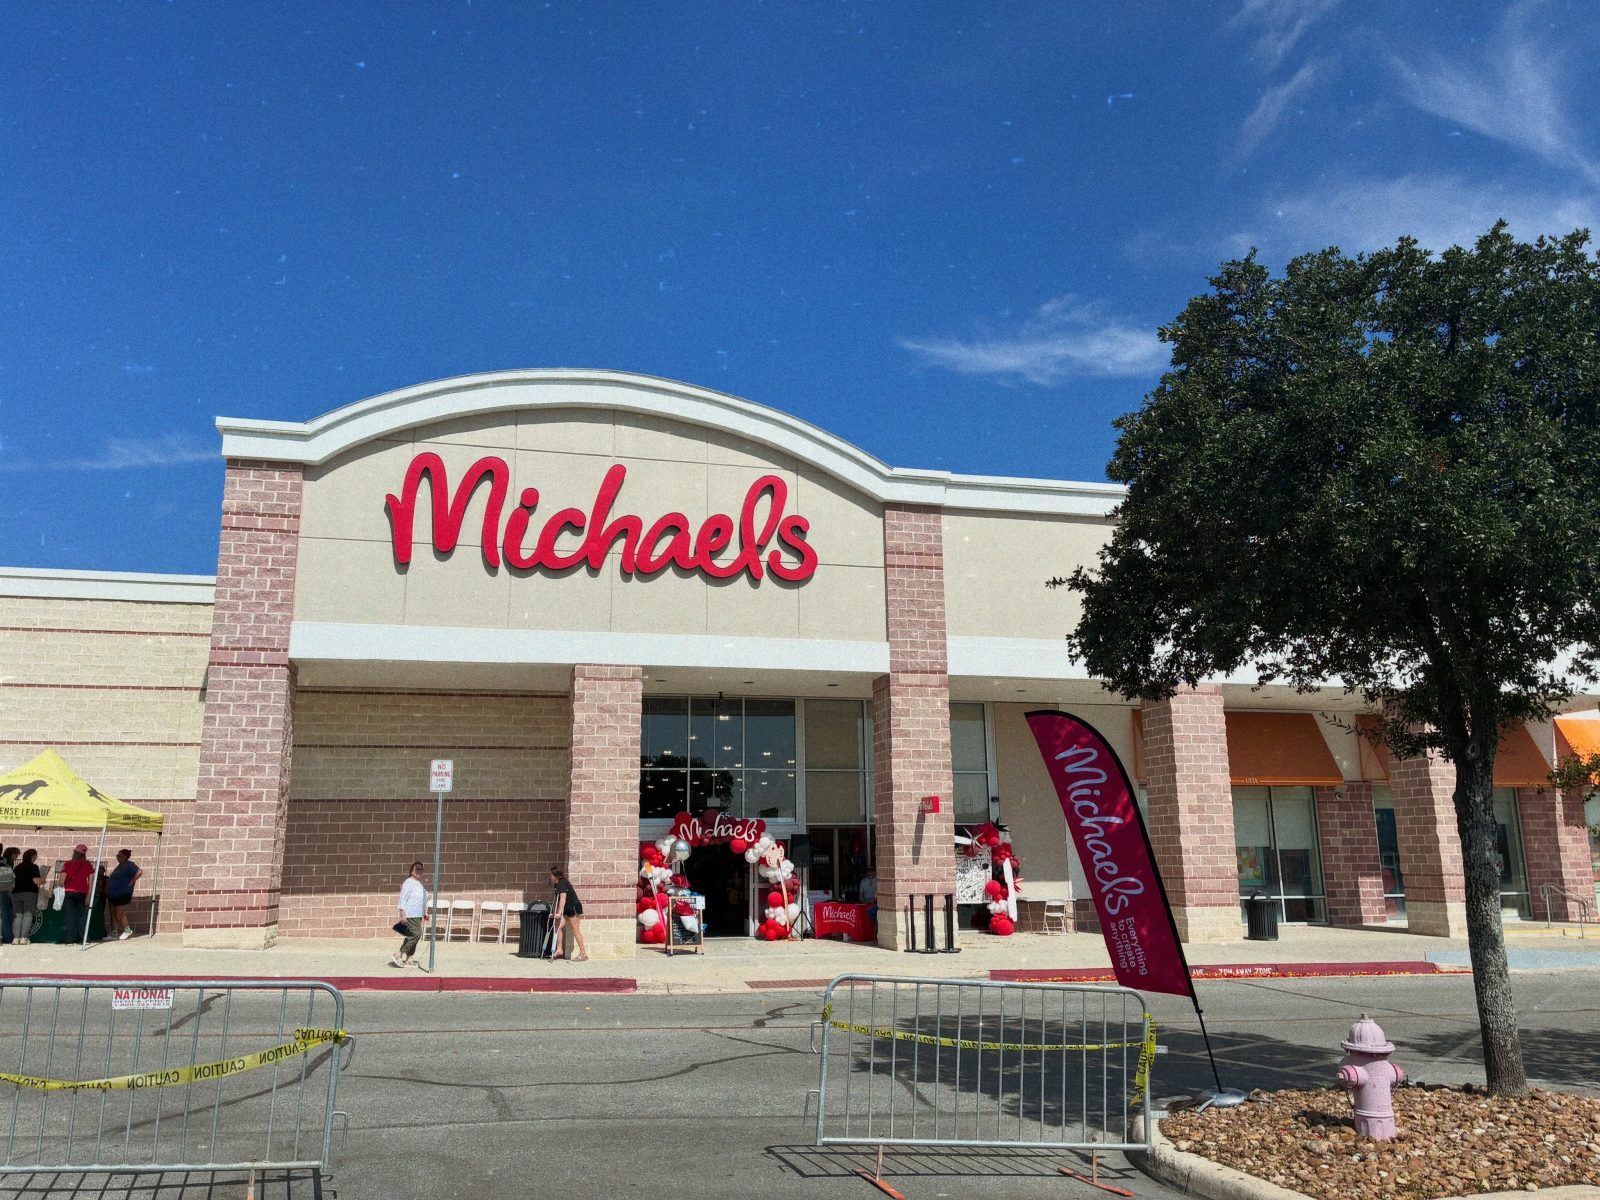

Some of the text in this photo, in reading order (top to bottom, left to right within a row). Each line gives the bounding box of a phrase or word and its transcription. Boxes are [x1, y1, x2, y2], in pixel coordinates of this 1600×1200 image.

[384, 451, 818, 581] Michaels
[21, 808, 51, 817] LEAGUE
[1054, 743, 1145, 916] Michaels
[822, 905, 857, 923] Michaels
[1117, 919, 1136, 968] to create
[1125, 916, 1148, 976] Everything
[114, 989, 171, 999] NATIONAL
